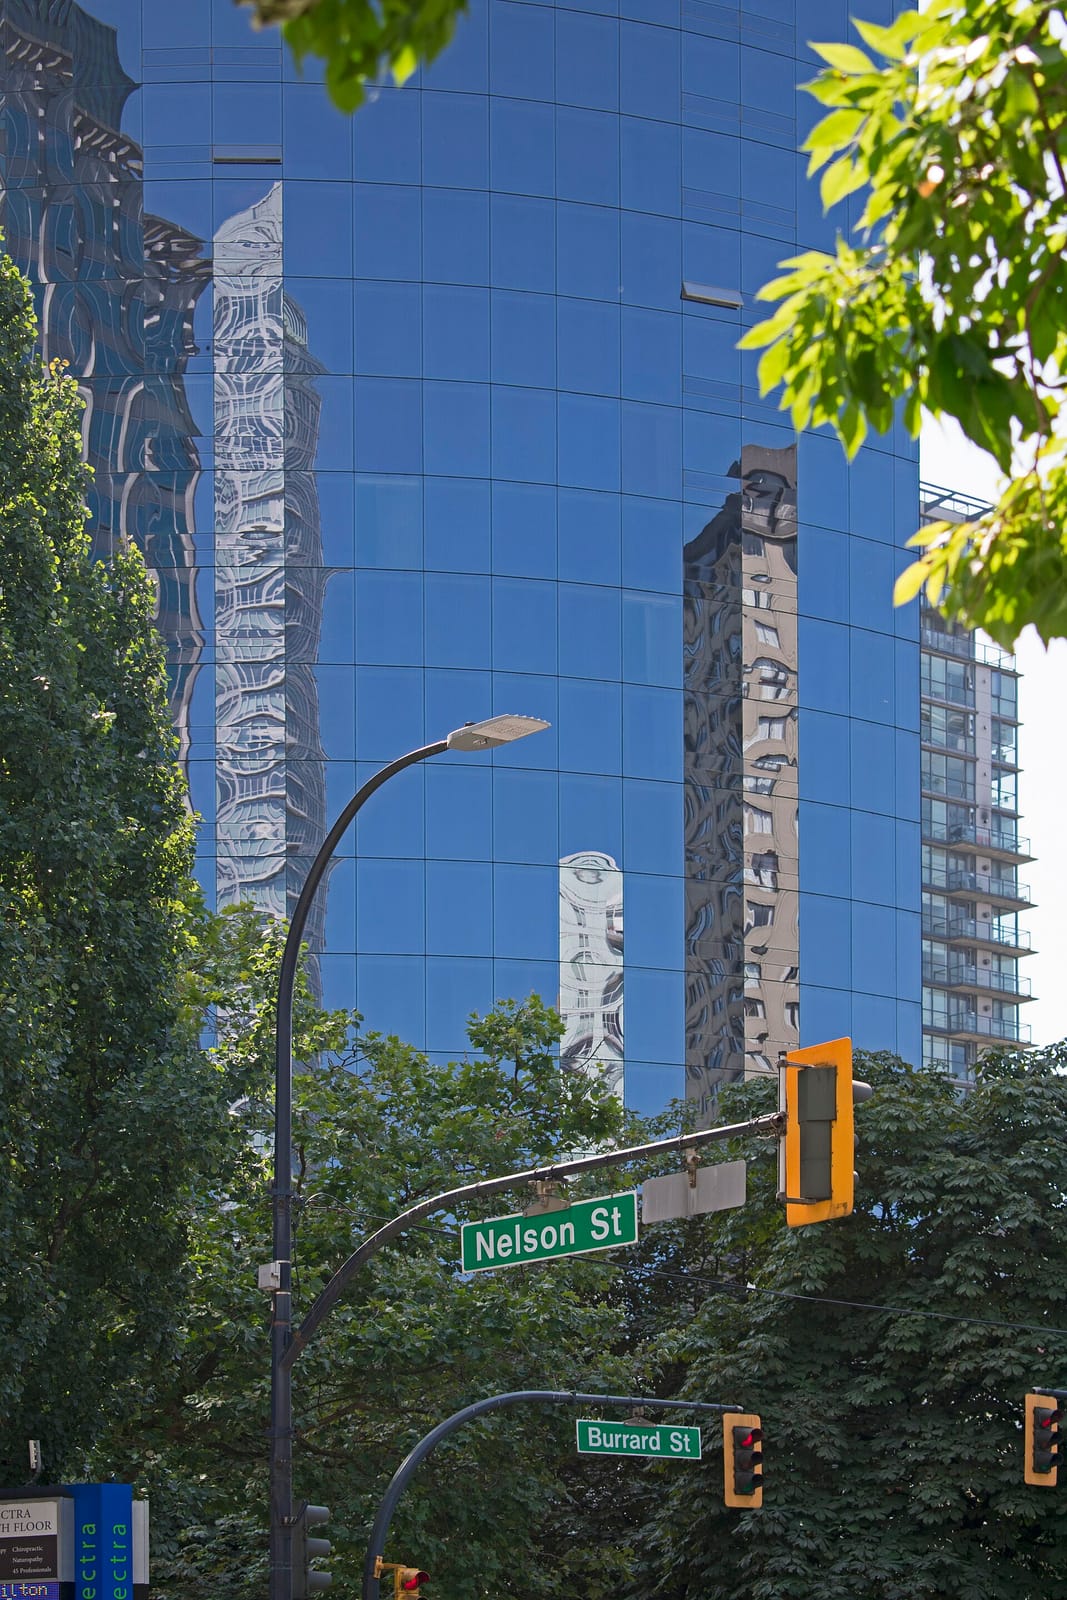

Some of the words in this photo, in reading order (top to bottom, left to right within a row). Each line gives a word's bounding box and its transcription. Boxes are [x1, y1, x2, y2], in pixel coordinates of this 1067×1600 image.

[476, 1222, 575, 1261] Nelson
[591, 1206, 622, 1240] St
[587, 1426, 661, 1451] Burrard
[669, 1431, 691, 1452] St
[0, 1509, 31, 1519] CTRA
[14, 1520, 52, 1531] FLOOR
[80, 1523, 96, 1600] ectra
[110, 1523, 127, 1600] ectra
[1, 1584, 48, 1597] ilton
